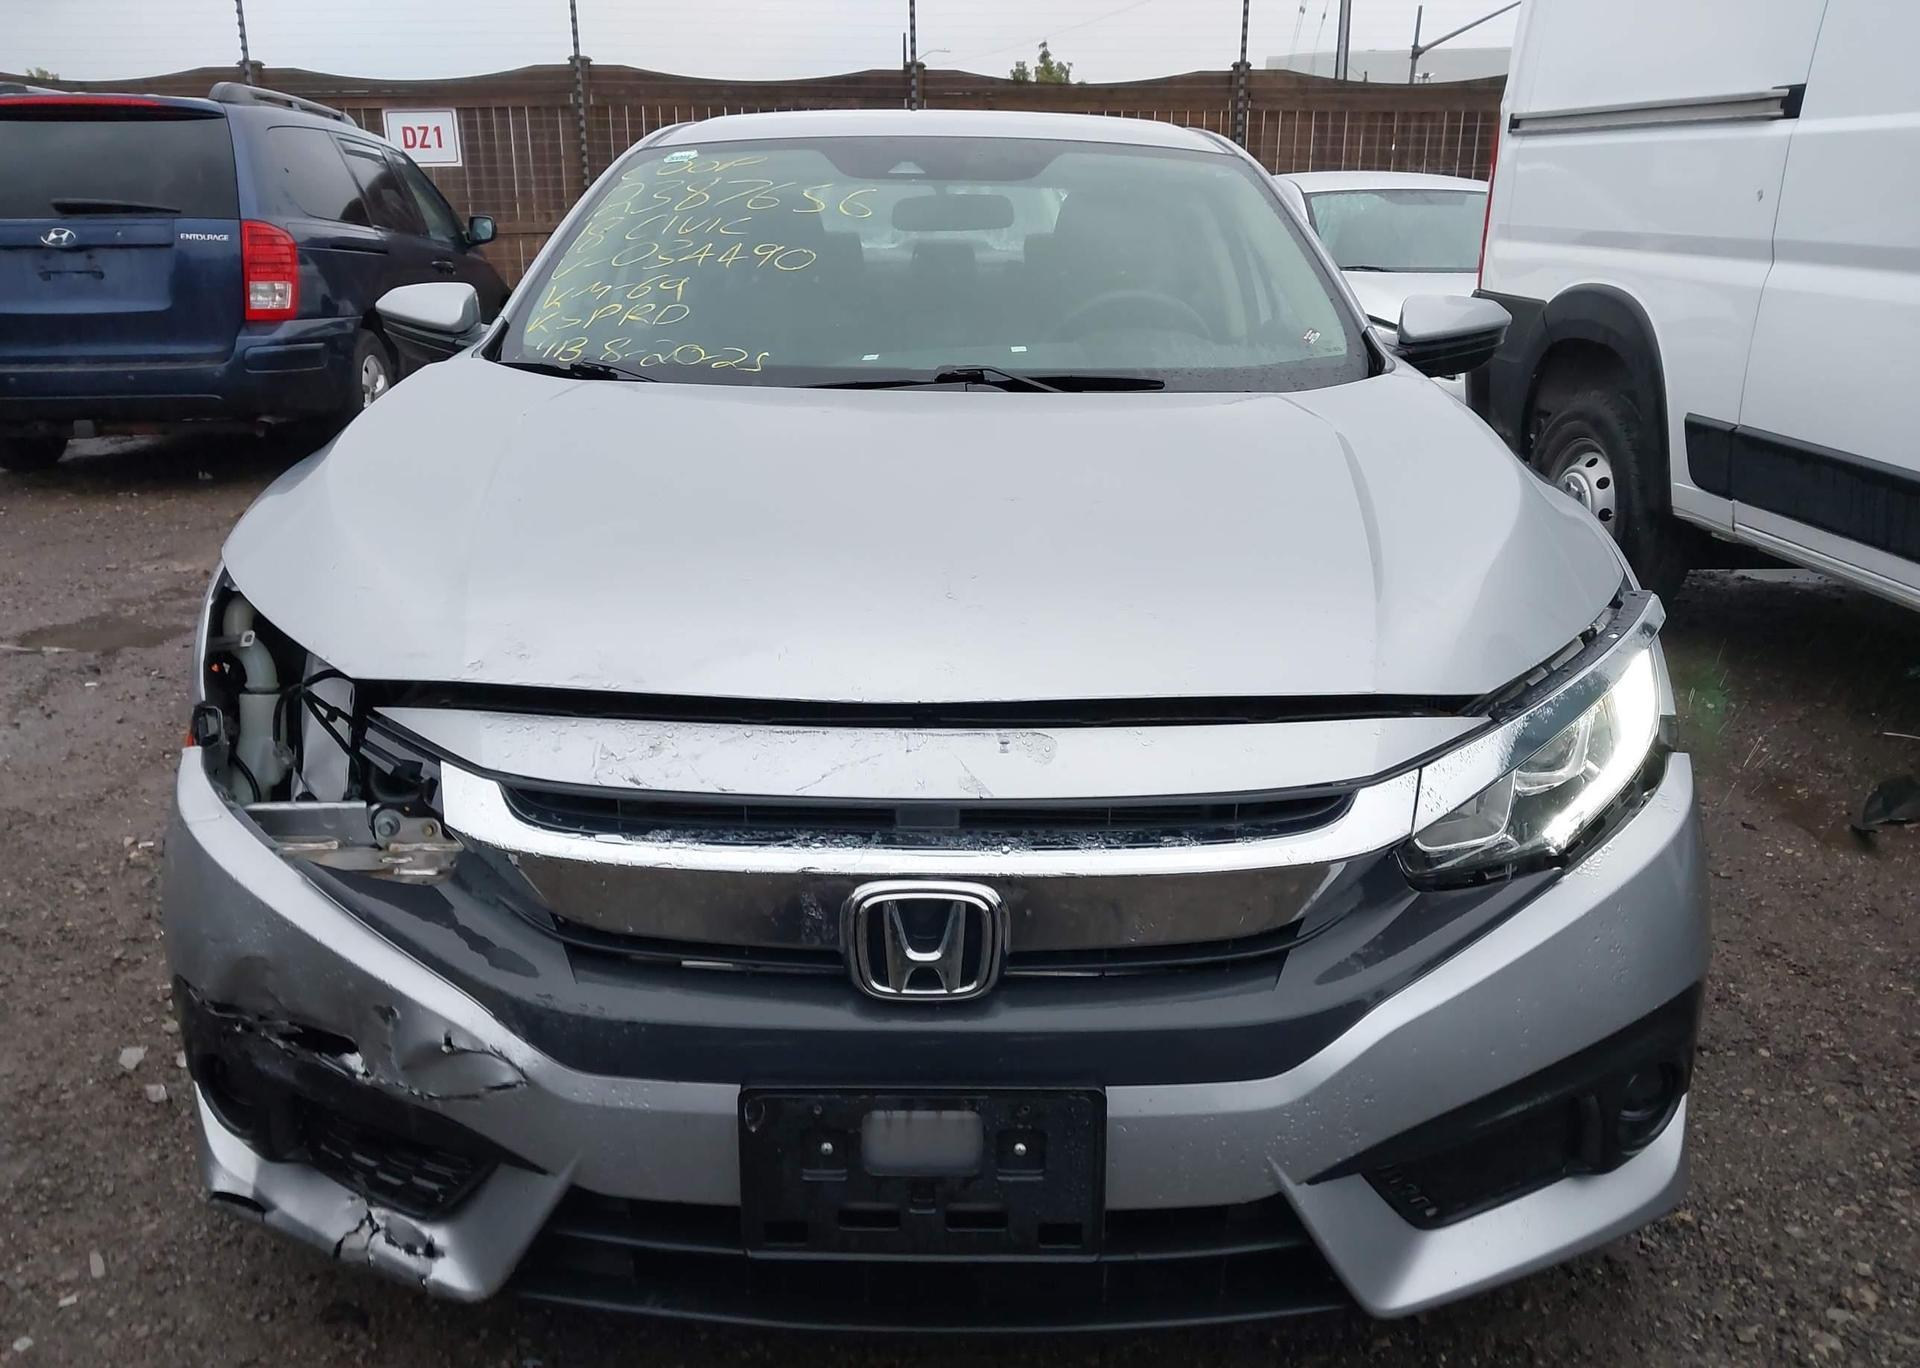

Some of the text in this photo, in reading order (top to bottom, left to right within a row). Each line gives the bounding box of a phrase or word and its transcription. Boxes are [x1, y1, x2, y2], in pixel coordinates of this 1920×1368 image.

[402, 126, 442, 149] DZ1
[180, 233, 229, 241] ENTOURAGE
[625, 214, 752, 240] CIVIC
